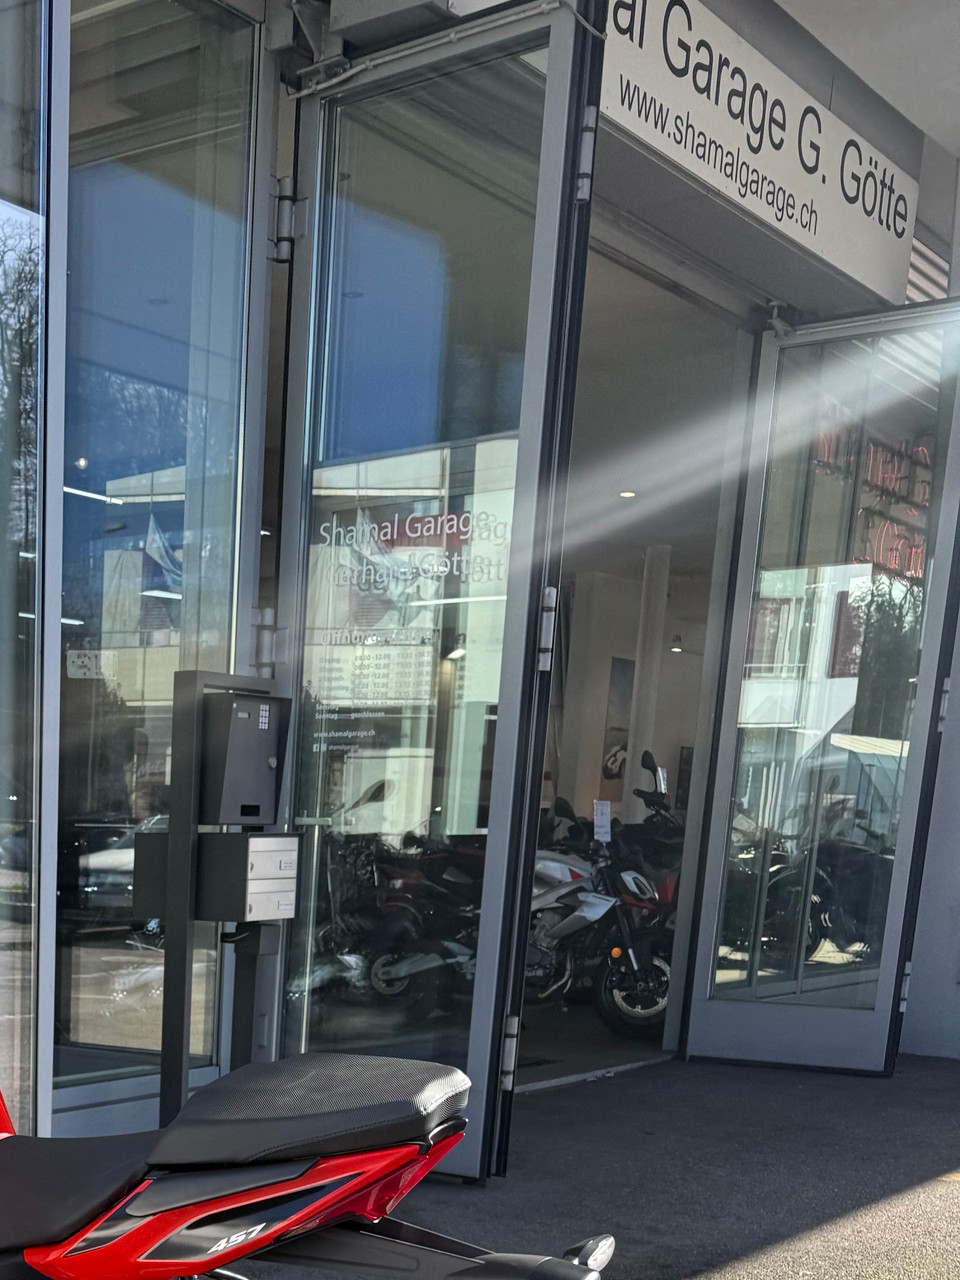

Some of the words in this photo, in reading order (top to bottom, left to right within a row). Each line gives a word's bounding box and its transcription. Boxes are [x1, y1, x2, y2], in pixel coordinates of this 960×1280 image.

[619, 73, 819, 237] www.shamalgarage.ch
[661, 0, 787, 155] Garage
[796, 105, 827, 185] G.
[839, 138, 909, 240] Götte
[319, 513, 398, 547] Shamal
[405, 510, 490, 542] Garage
[206, 1222, 267, 1255] 457
